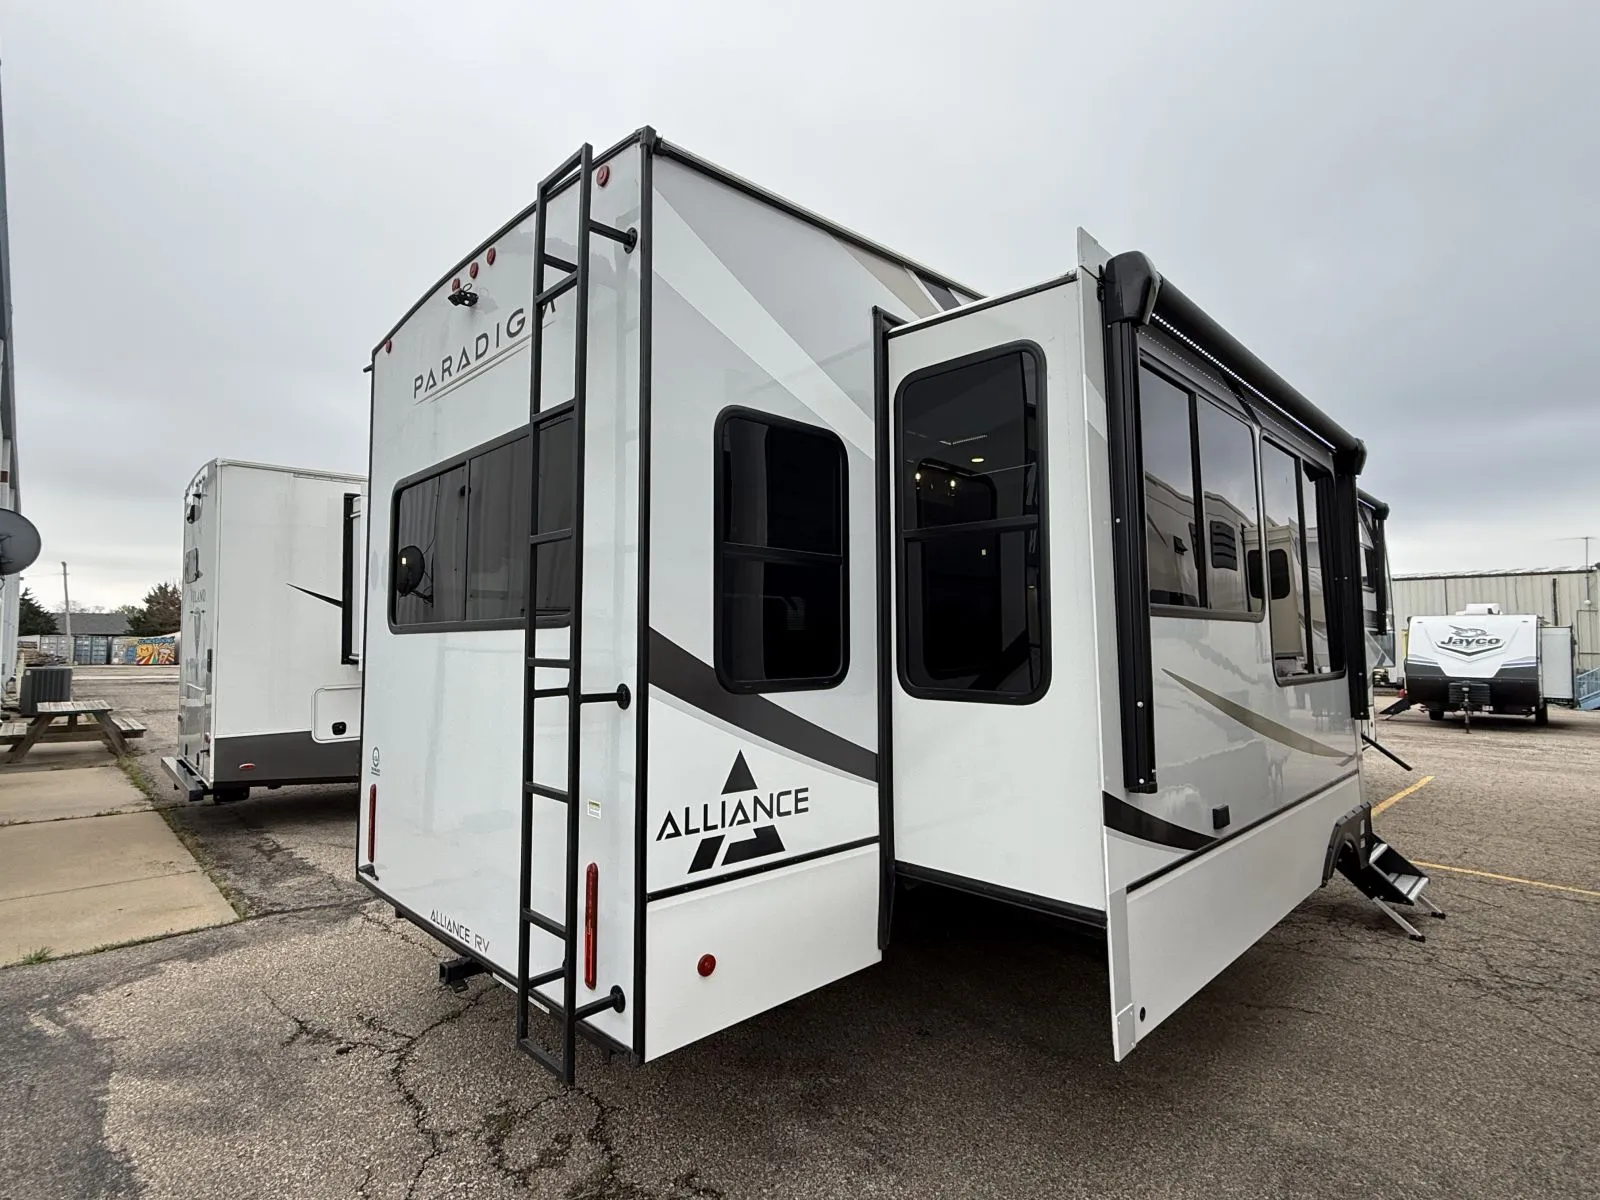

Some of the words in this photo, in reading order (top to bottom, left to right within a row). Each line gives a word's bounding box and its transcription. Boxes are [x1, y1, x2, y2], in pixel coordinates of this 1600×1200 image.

[1440, 636, 1501, 646] Jayco
[656, 787, 809, 841] ALLIANCE
[430, 909, 470, 944] ALLIANCE
[474, 933, 490, 953] RV
